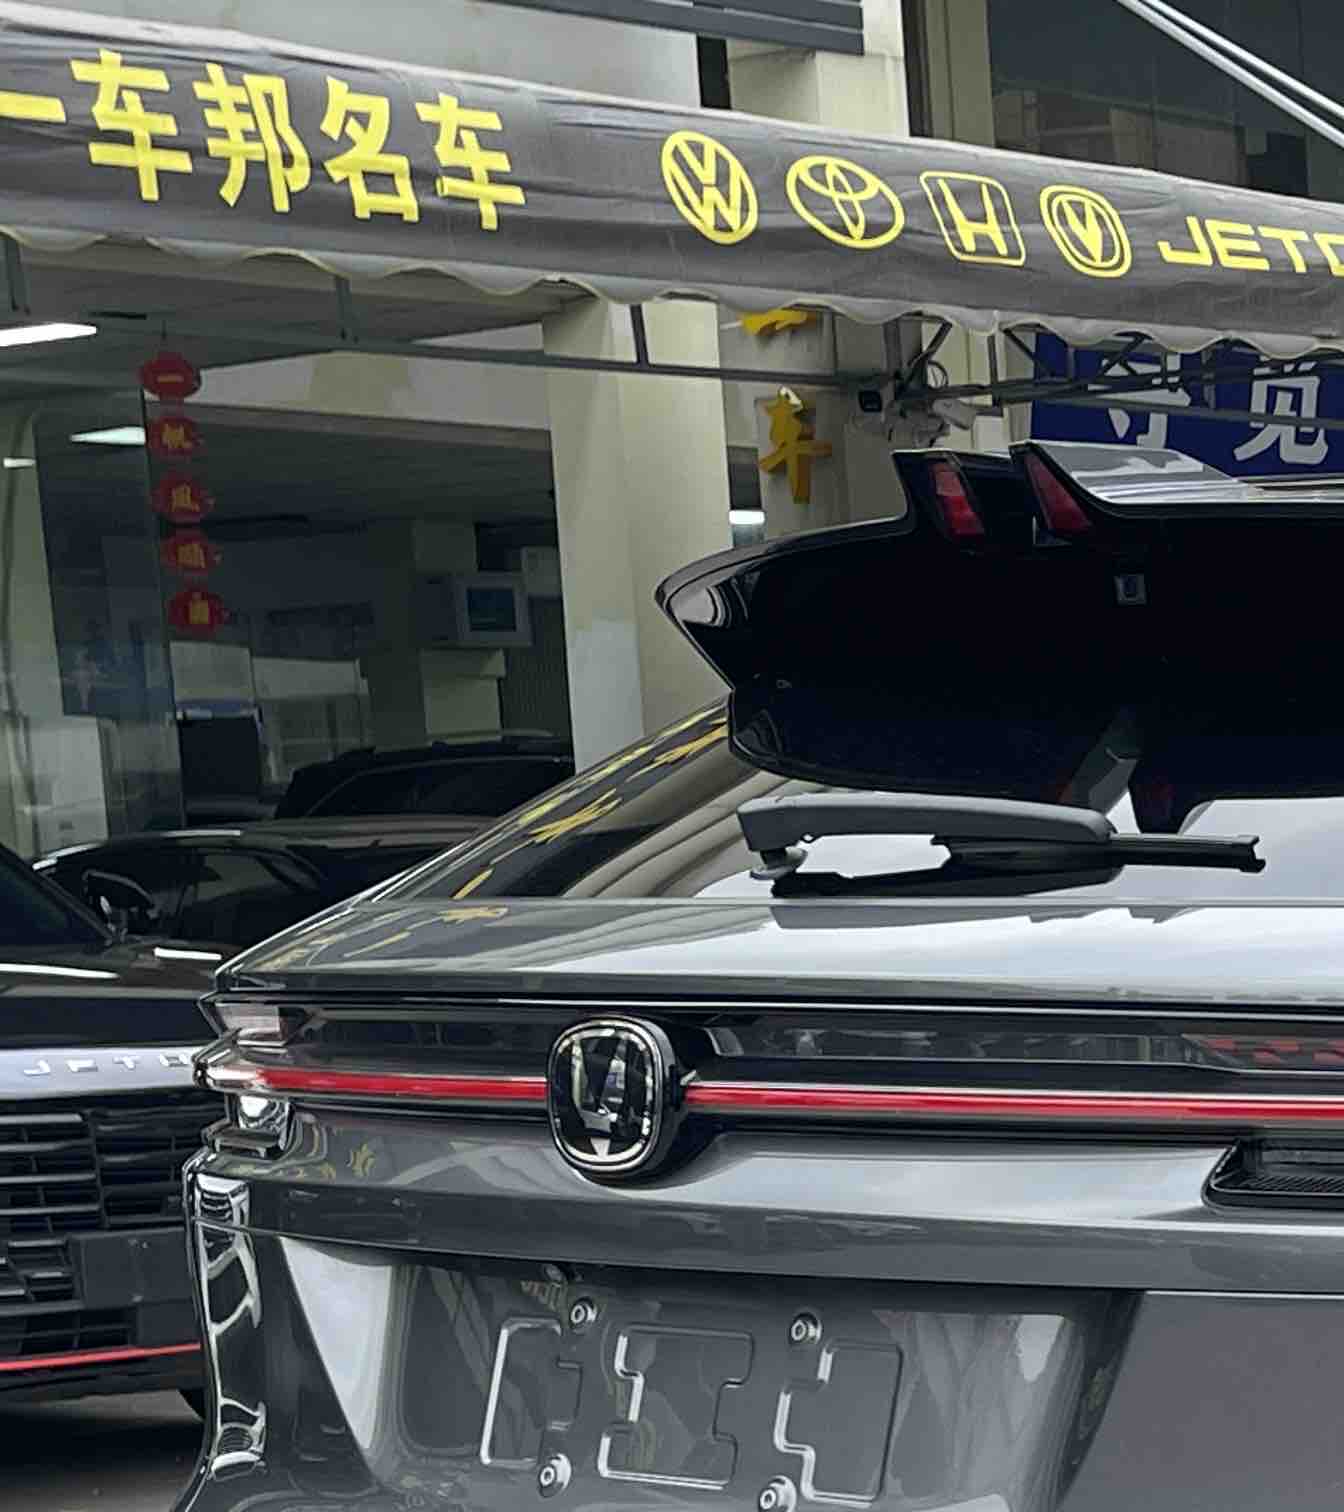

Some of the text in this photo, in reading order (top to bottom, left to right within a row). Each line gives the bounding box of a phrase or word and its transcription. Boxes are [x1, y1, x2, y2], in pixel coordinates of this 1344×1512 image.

[0, 48, 526, 231] 一车邦名车
